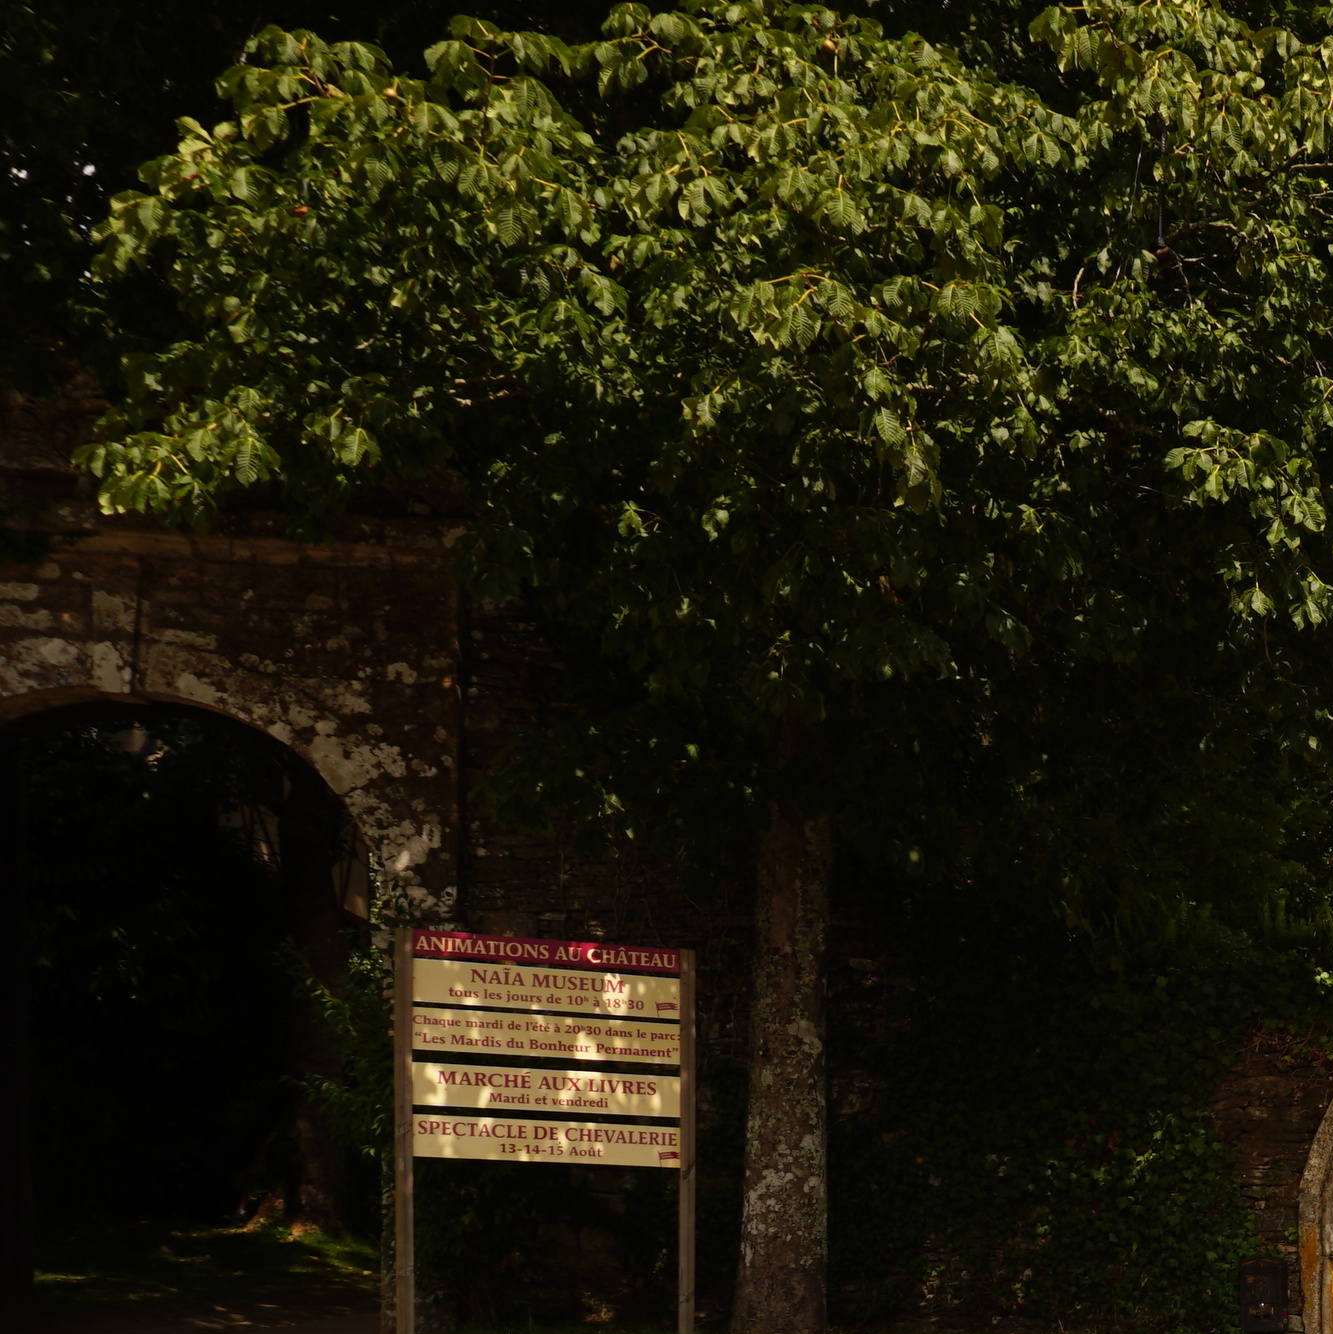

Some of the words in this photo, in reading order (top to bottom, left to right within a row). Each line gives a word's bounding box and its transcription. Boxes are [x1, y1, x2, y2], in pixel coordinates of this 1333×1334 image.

[415, 935, 549, 959] ANIMATIONS
[554, 946, 582, 961] AU
[587, 947, 676, 968] CHÂTEAU
[532, 973, 624, 994] MUSEUM
[448, 987, 479, 999] tous
[484, 989, 502, 1000] les
[506, 990, 542, 1003] jours
[546, 994, 562, 1004] de
[593, 997, 600, 1007] à
[605, 998, 644, 1010] 18h30
[412, 1014, 461, 1028] Chaque
[465, 1019, 503, 1030] mardi
[508, 1021, 521, 1031] de
[554, 1023, 561, 1033] à
[605, 1027, 633, 1038] dans
[637, 1029, 647, 1039] le
[450, 1034, 502, 1048] Mardis
[506, 1037, 525, 1049] du
[529, 1039, 591, 1053] Bonheur
[437, 1070, 532, 1089] MARCHÉ
[538, 1076, 582, 1092] AUX
[588, 1078, 657, 1096] LIVRES
[489, 1092, 530, 1104] Mardi
[534, 1095, 548, 1105] et
[552, 1096, 609, 1108] vendredi
[418, 1120, 528, 1139] SPECTACLE
[532, 1126, 559, 1141] DE
[565, 1127, 678, 1147] CHEVALERIE
[499, 1143, 564, 1156] 13-14-15
[569, 1146, 603, 1158] Août
